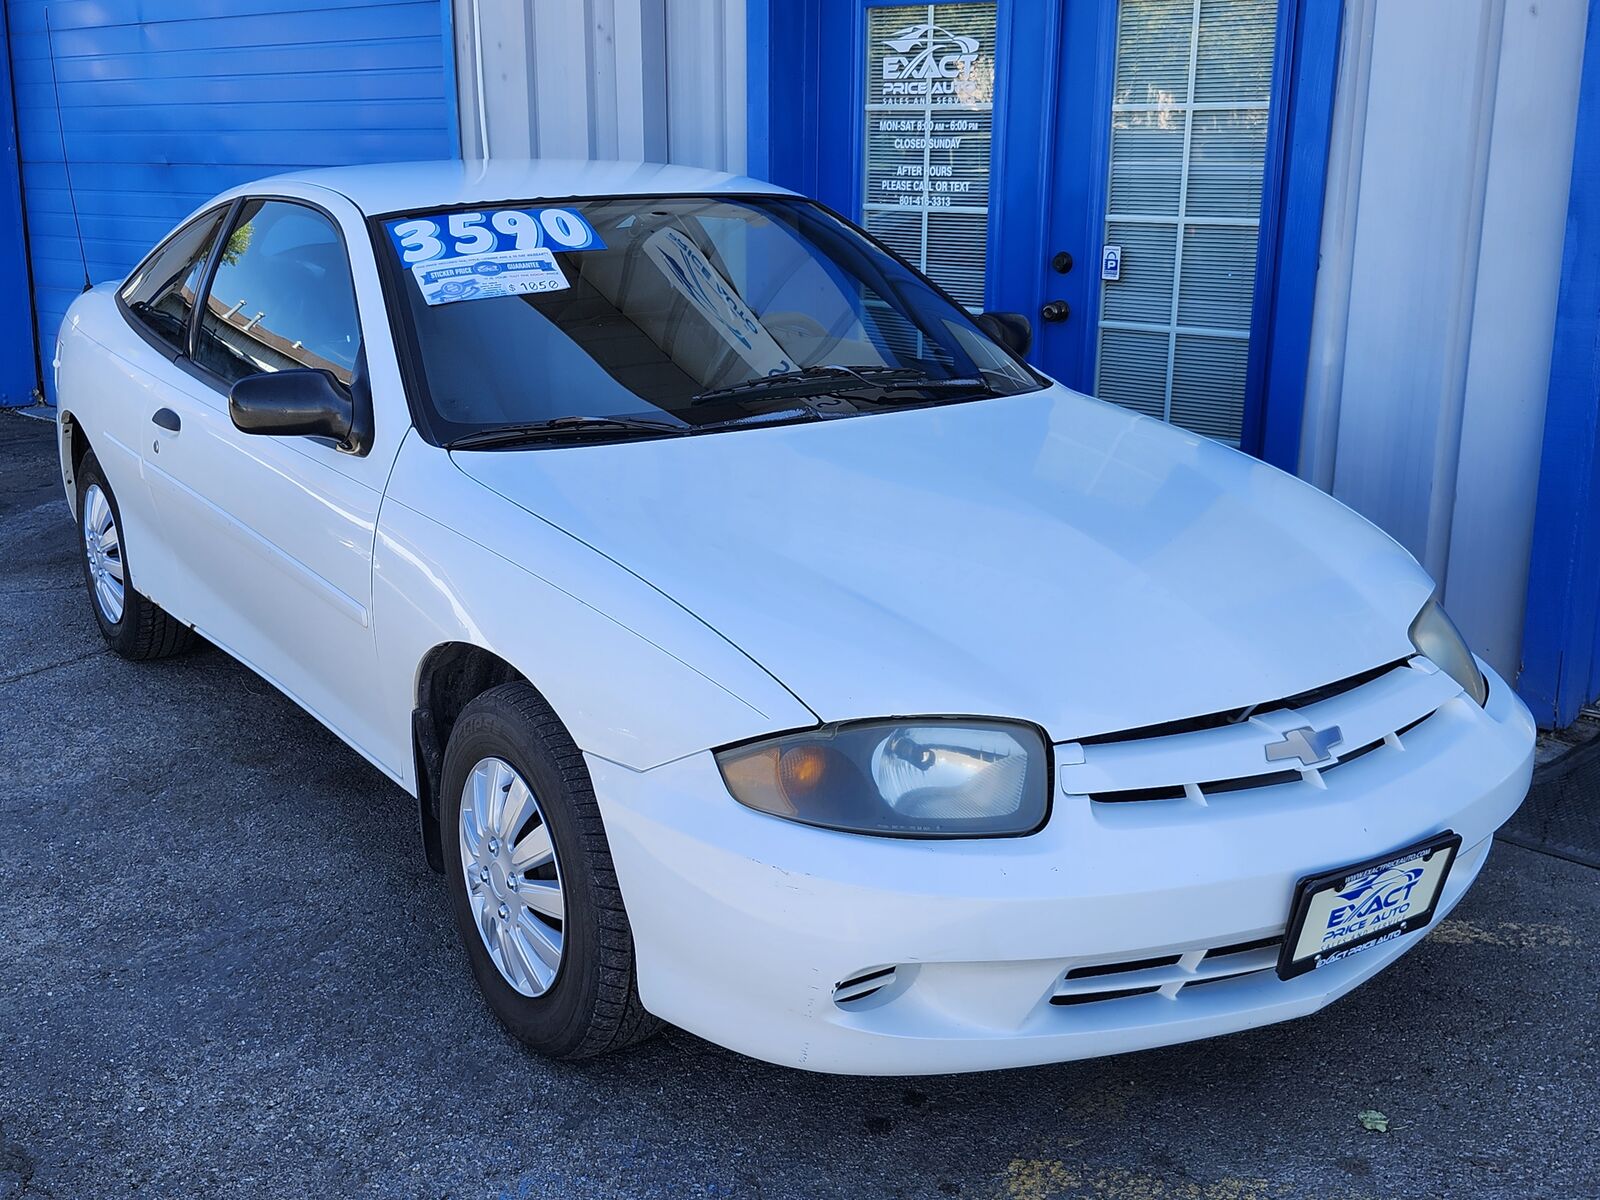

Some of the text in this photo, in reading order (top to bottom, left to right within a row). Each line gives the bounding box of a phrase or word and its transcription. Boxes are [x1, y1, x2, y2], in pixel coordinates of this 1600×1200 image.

[882, 53, 979, 80] EXACT
[882, 81, 977, 95] PRICE AUTO
[882, 97, 909, 105] SALES
[880, 120, 914, 131] MON-SAT
[949, 120, 968, 131] 6:00
[968, 123, 979, 131] PM
[894, 138, 961, 149] CLOSED SUNDAY
[896, 166, 922, 177] AFTER
[881, 180, 911, 191] PLEASE
[935, 181, 948, 192] OR
[949, 182, 970, 192] TEXT
[394, 208, 593, 263] 3590
[430, 268, 455, 280] STICKER
[454, 267, 472, 276] PRICE
[507, 262, 541, 270] GUARANTEE
[1344, 848, 1431, 884] WWW.EXACTPRICEAUTO.COM
[1326, 879, 1420, 929] EXACT
[1322, 902, 1411, 943] PRICE AUTO
[1315, 929, 1402, 969] EXACT PRICE AUTO
